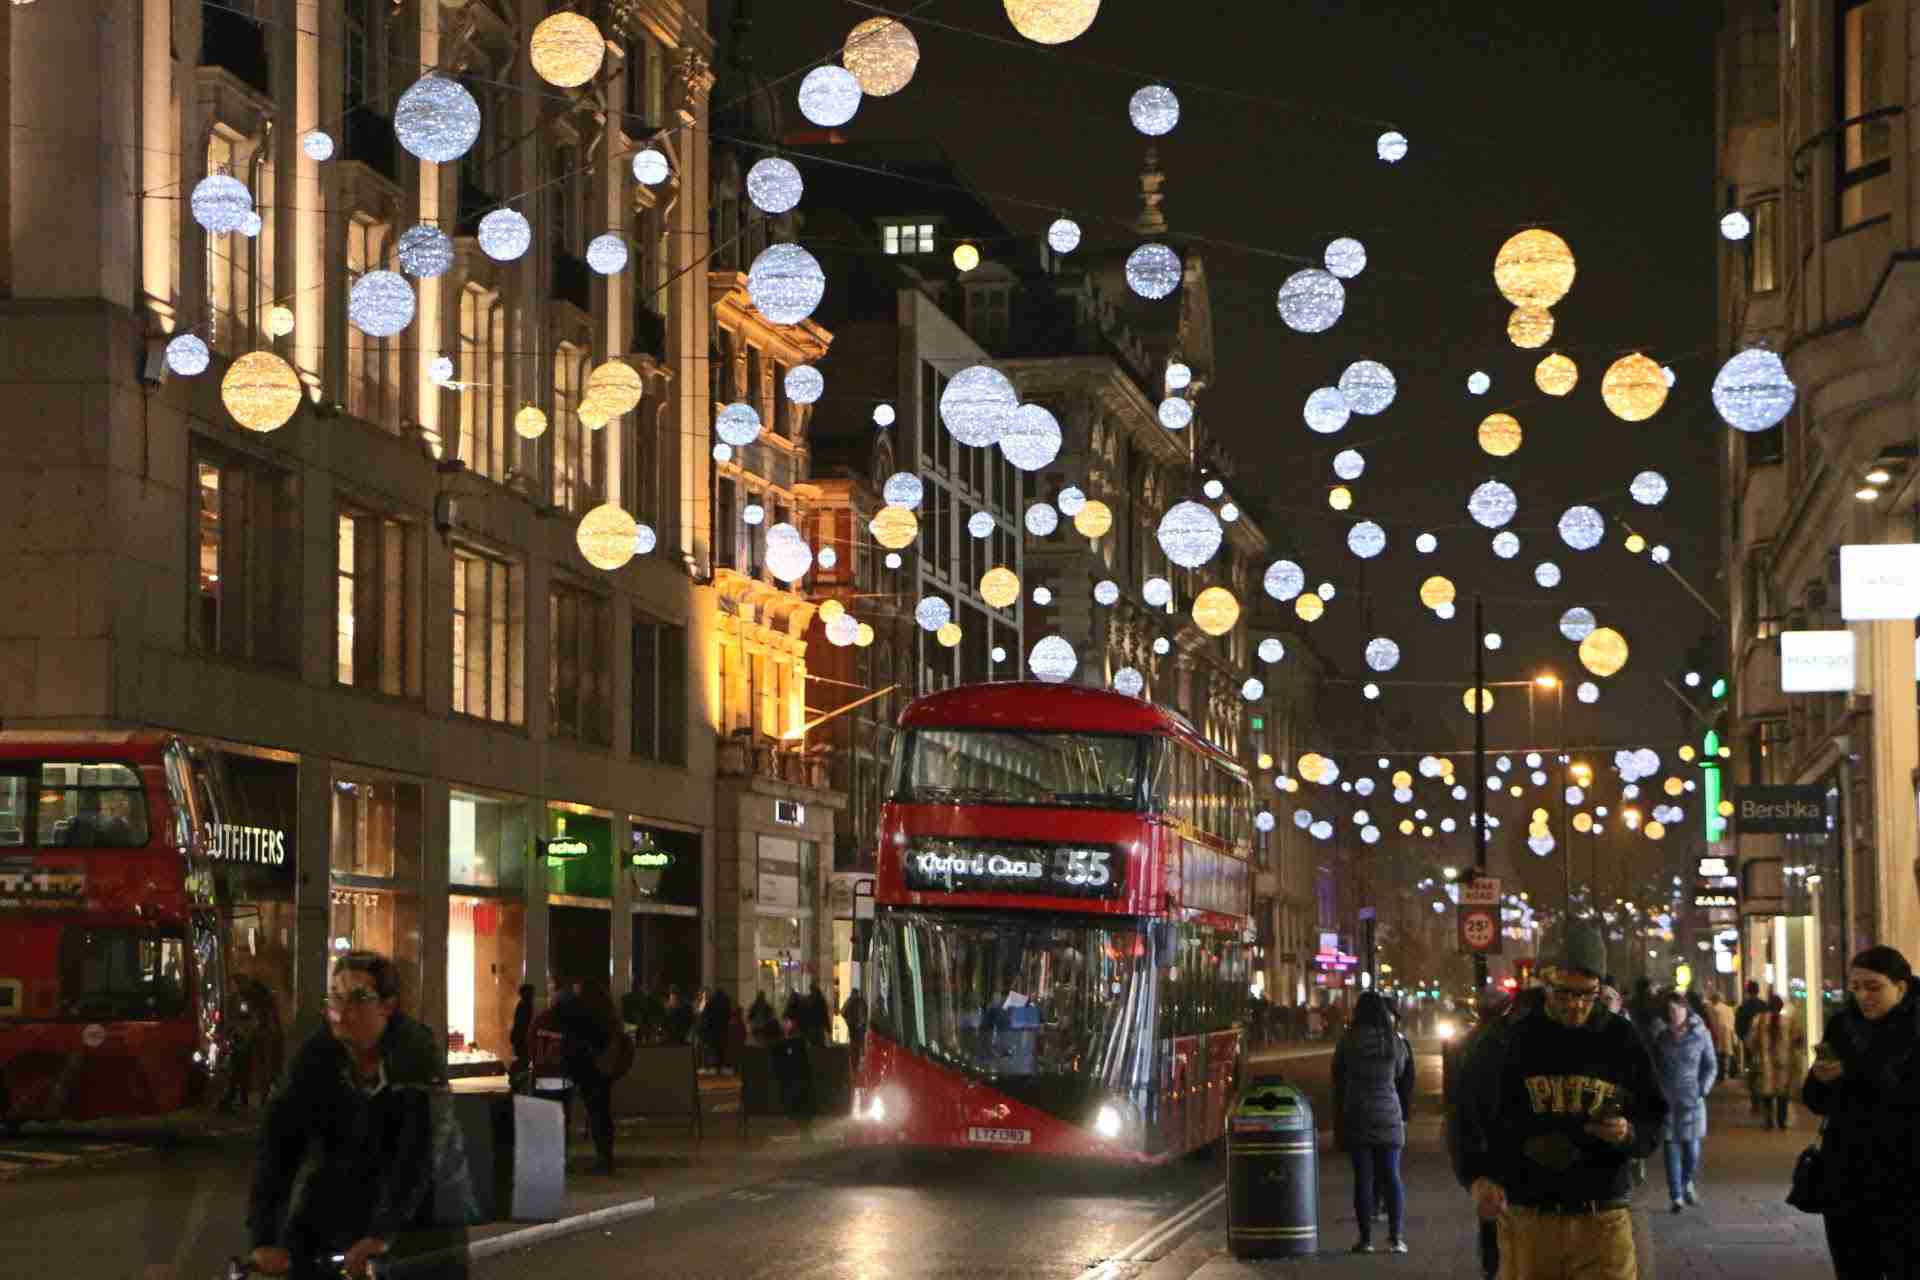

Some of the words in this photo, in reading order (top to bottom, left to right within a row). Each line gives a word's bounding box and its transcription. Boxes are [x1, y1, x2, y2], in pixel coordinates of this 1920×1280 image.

[1743, 800, 1820, 817] Bershka
[1694, 895, 1737, 906] ZARA
[1524, 1075, 1617, 1115] PITT
